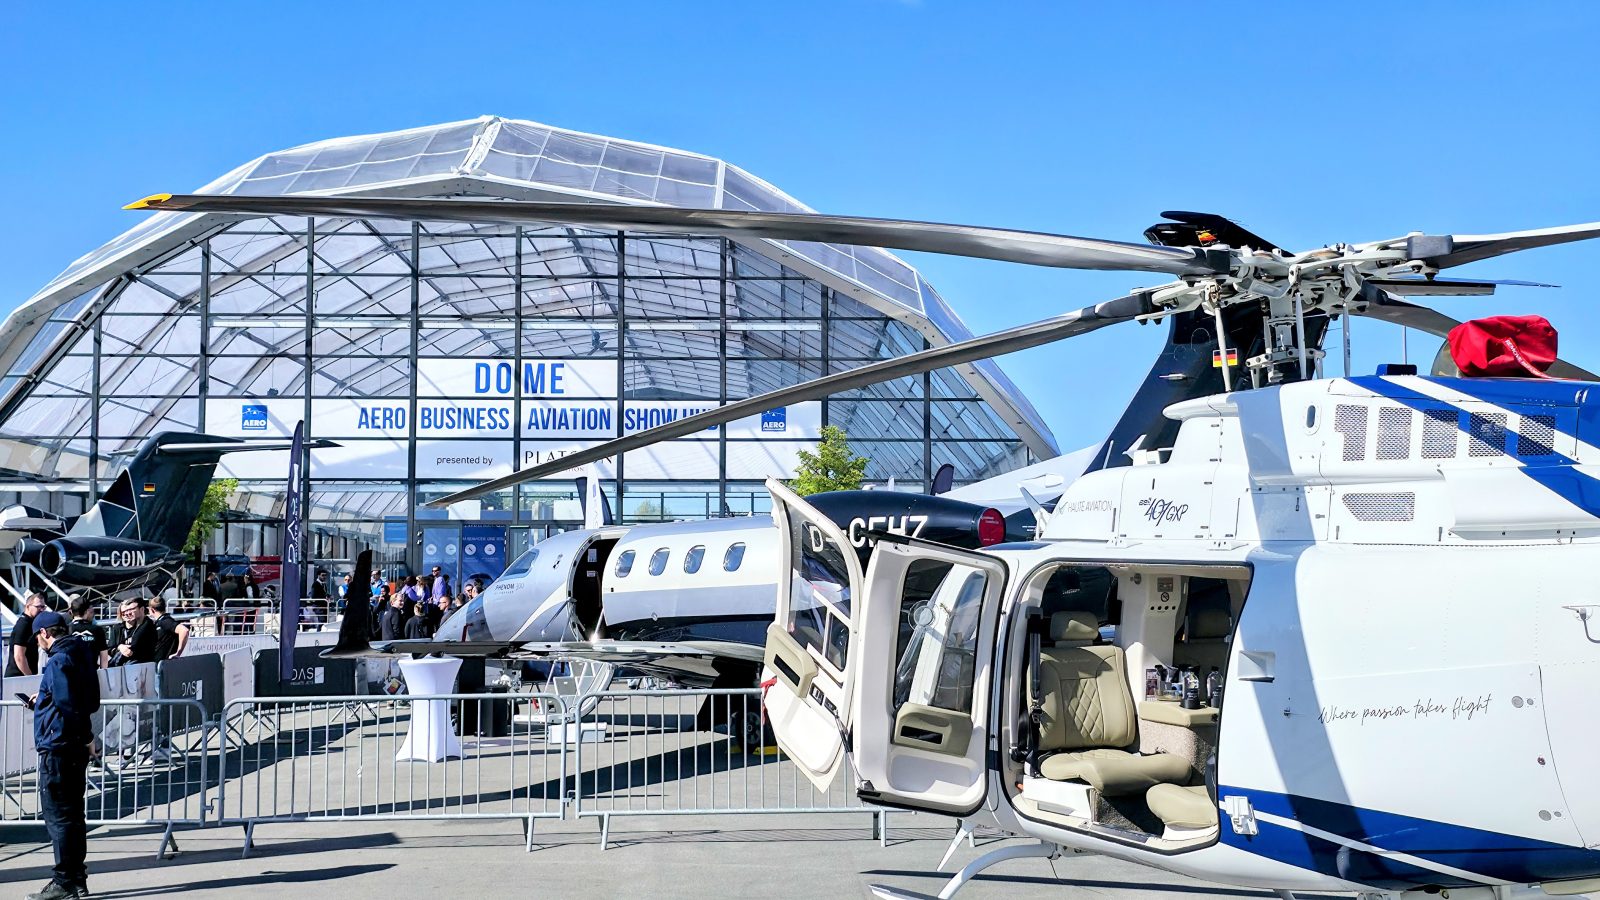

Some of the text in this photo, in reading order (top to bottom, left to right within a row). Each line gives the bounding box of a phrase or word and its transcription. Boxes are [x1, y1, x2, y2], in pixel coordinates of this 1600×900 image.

[475, 362, 565, 394] DOME
[243, 419, 267, 427] AERO
[358, 407, 406, 430] AERO
[420, 407, 510, 430] BUSINESS
[527, 407, 611, 431] AVIATION
[625, 408, 678, 431] SHOW
[436, 455, 494, 466] presented by
[1067, 500, 1113, 513] HAUTE AVIATION
[88, 550, 146, 568] D-COIN
[1318, 693, 1492, 725] Where passion takes flight
